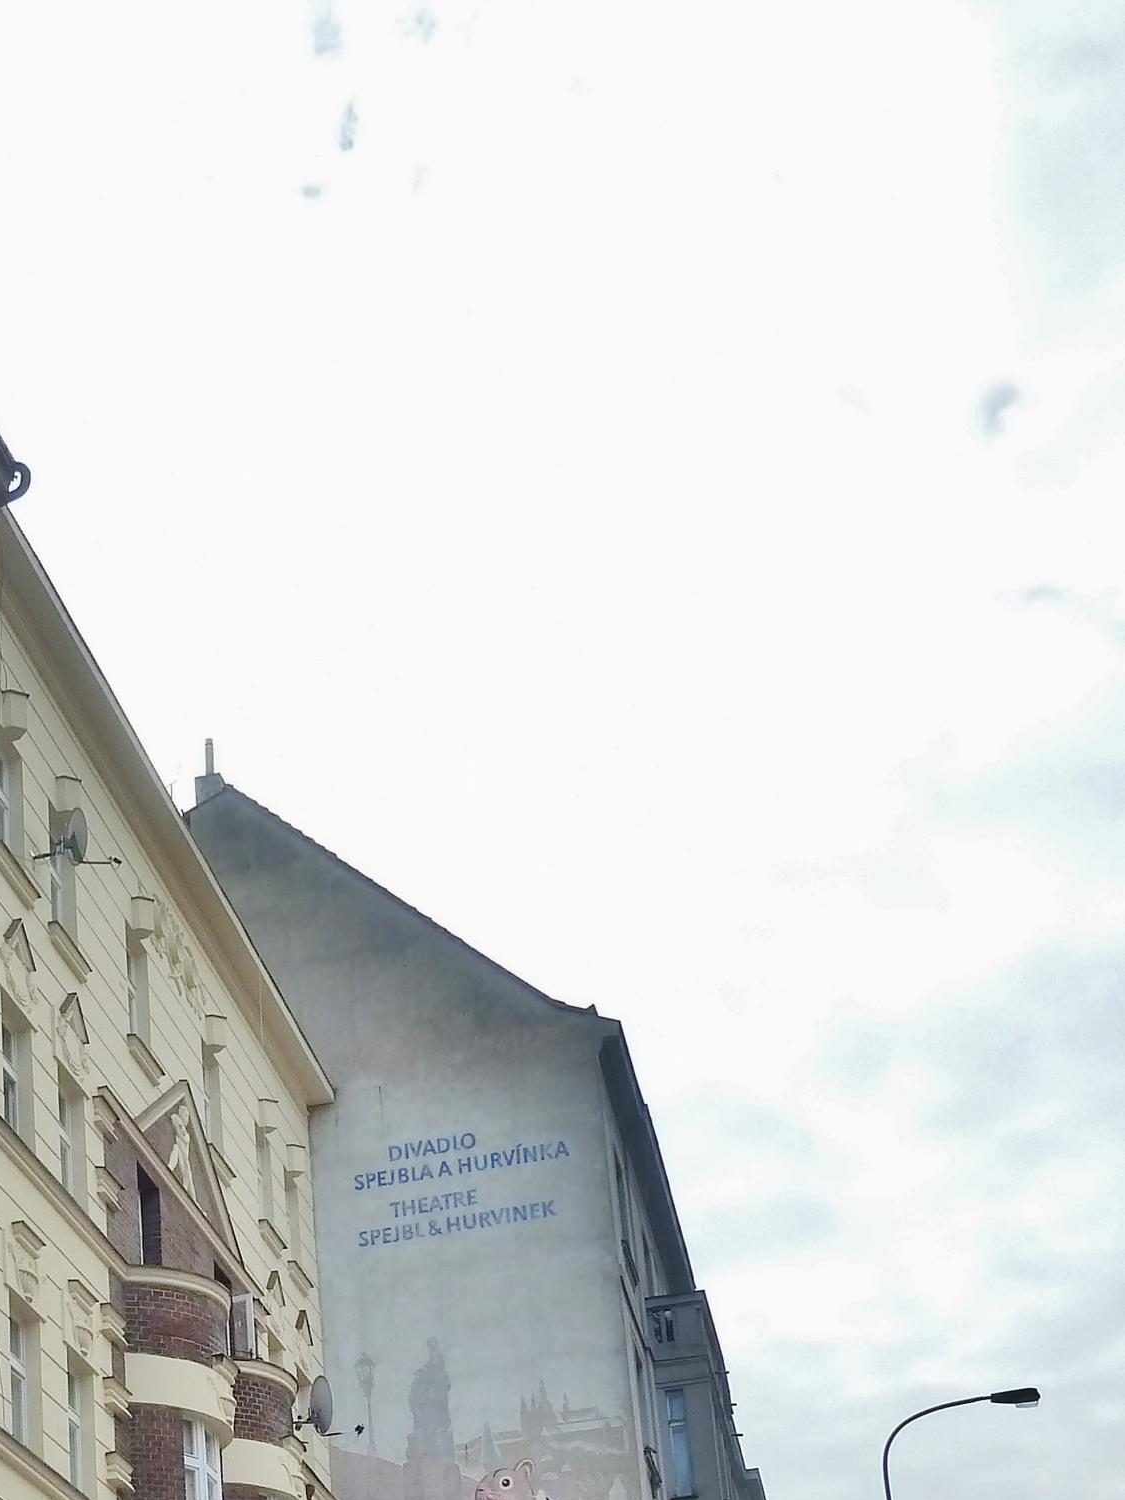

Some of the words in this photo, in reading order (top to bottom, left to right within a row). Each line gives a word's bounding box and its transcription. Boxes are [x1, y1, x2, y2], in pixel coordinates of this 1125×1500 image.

[354, 1163, 434, 1191] SPEJBLA
[438, 1161, 453, 1178] A
[457, 1141, 570, 1175] HURVÍNKA
[388, 1132, 477, 1162] DIVADLO
[358, 1219, 426, 1247] SPEJBL
[428, 1218, 443, 1236] &
[445, 1199, 557, 1234] HURVINEK
[390, 1189, 478, 1218] THEATRE
